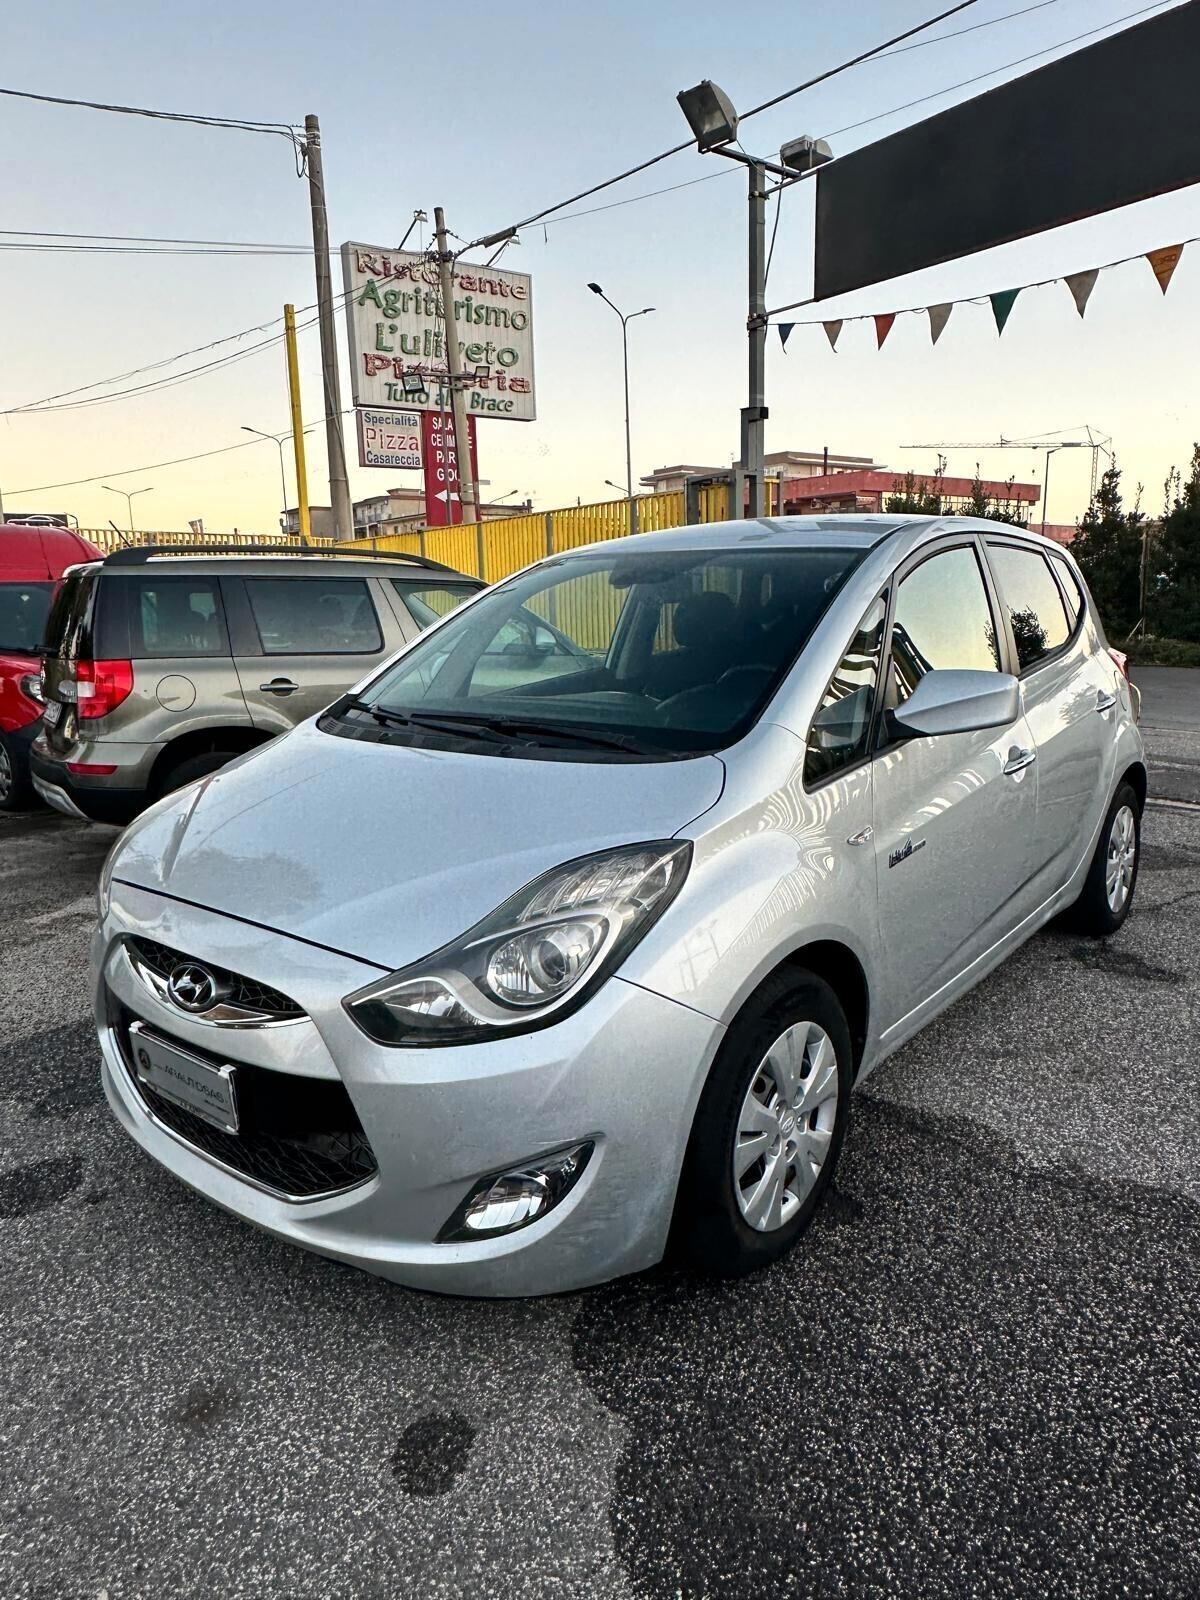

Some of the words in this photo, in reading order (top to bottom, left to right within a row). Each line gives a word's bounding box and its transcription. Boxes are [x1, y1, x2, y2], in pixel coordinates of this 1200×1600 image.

[356, 249, 528, 299] Ristoante
[470, 392, 514, 413] Brace
[364, 412, 418, 427] Specialità
[366, 427, 420, 451] Pizza
[366, 450, 421, 466] Casareccia
